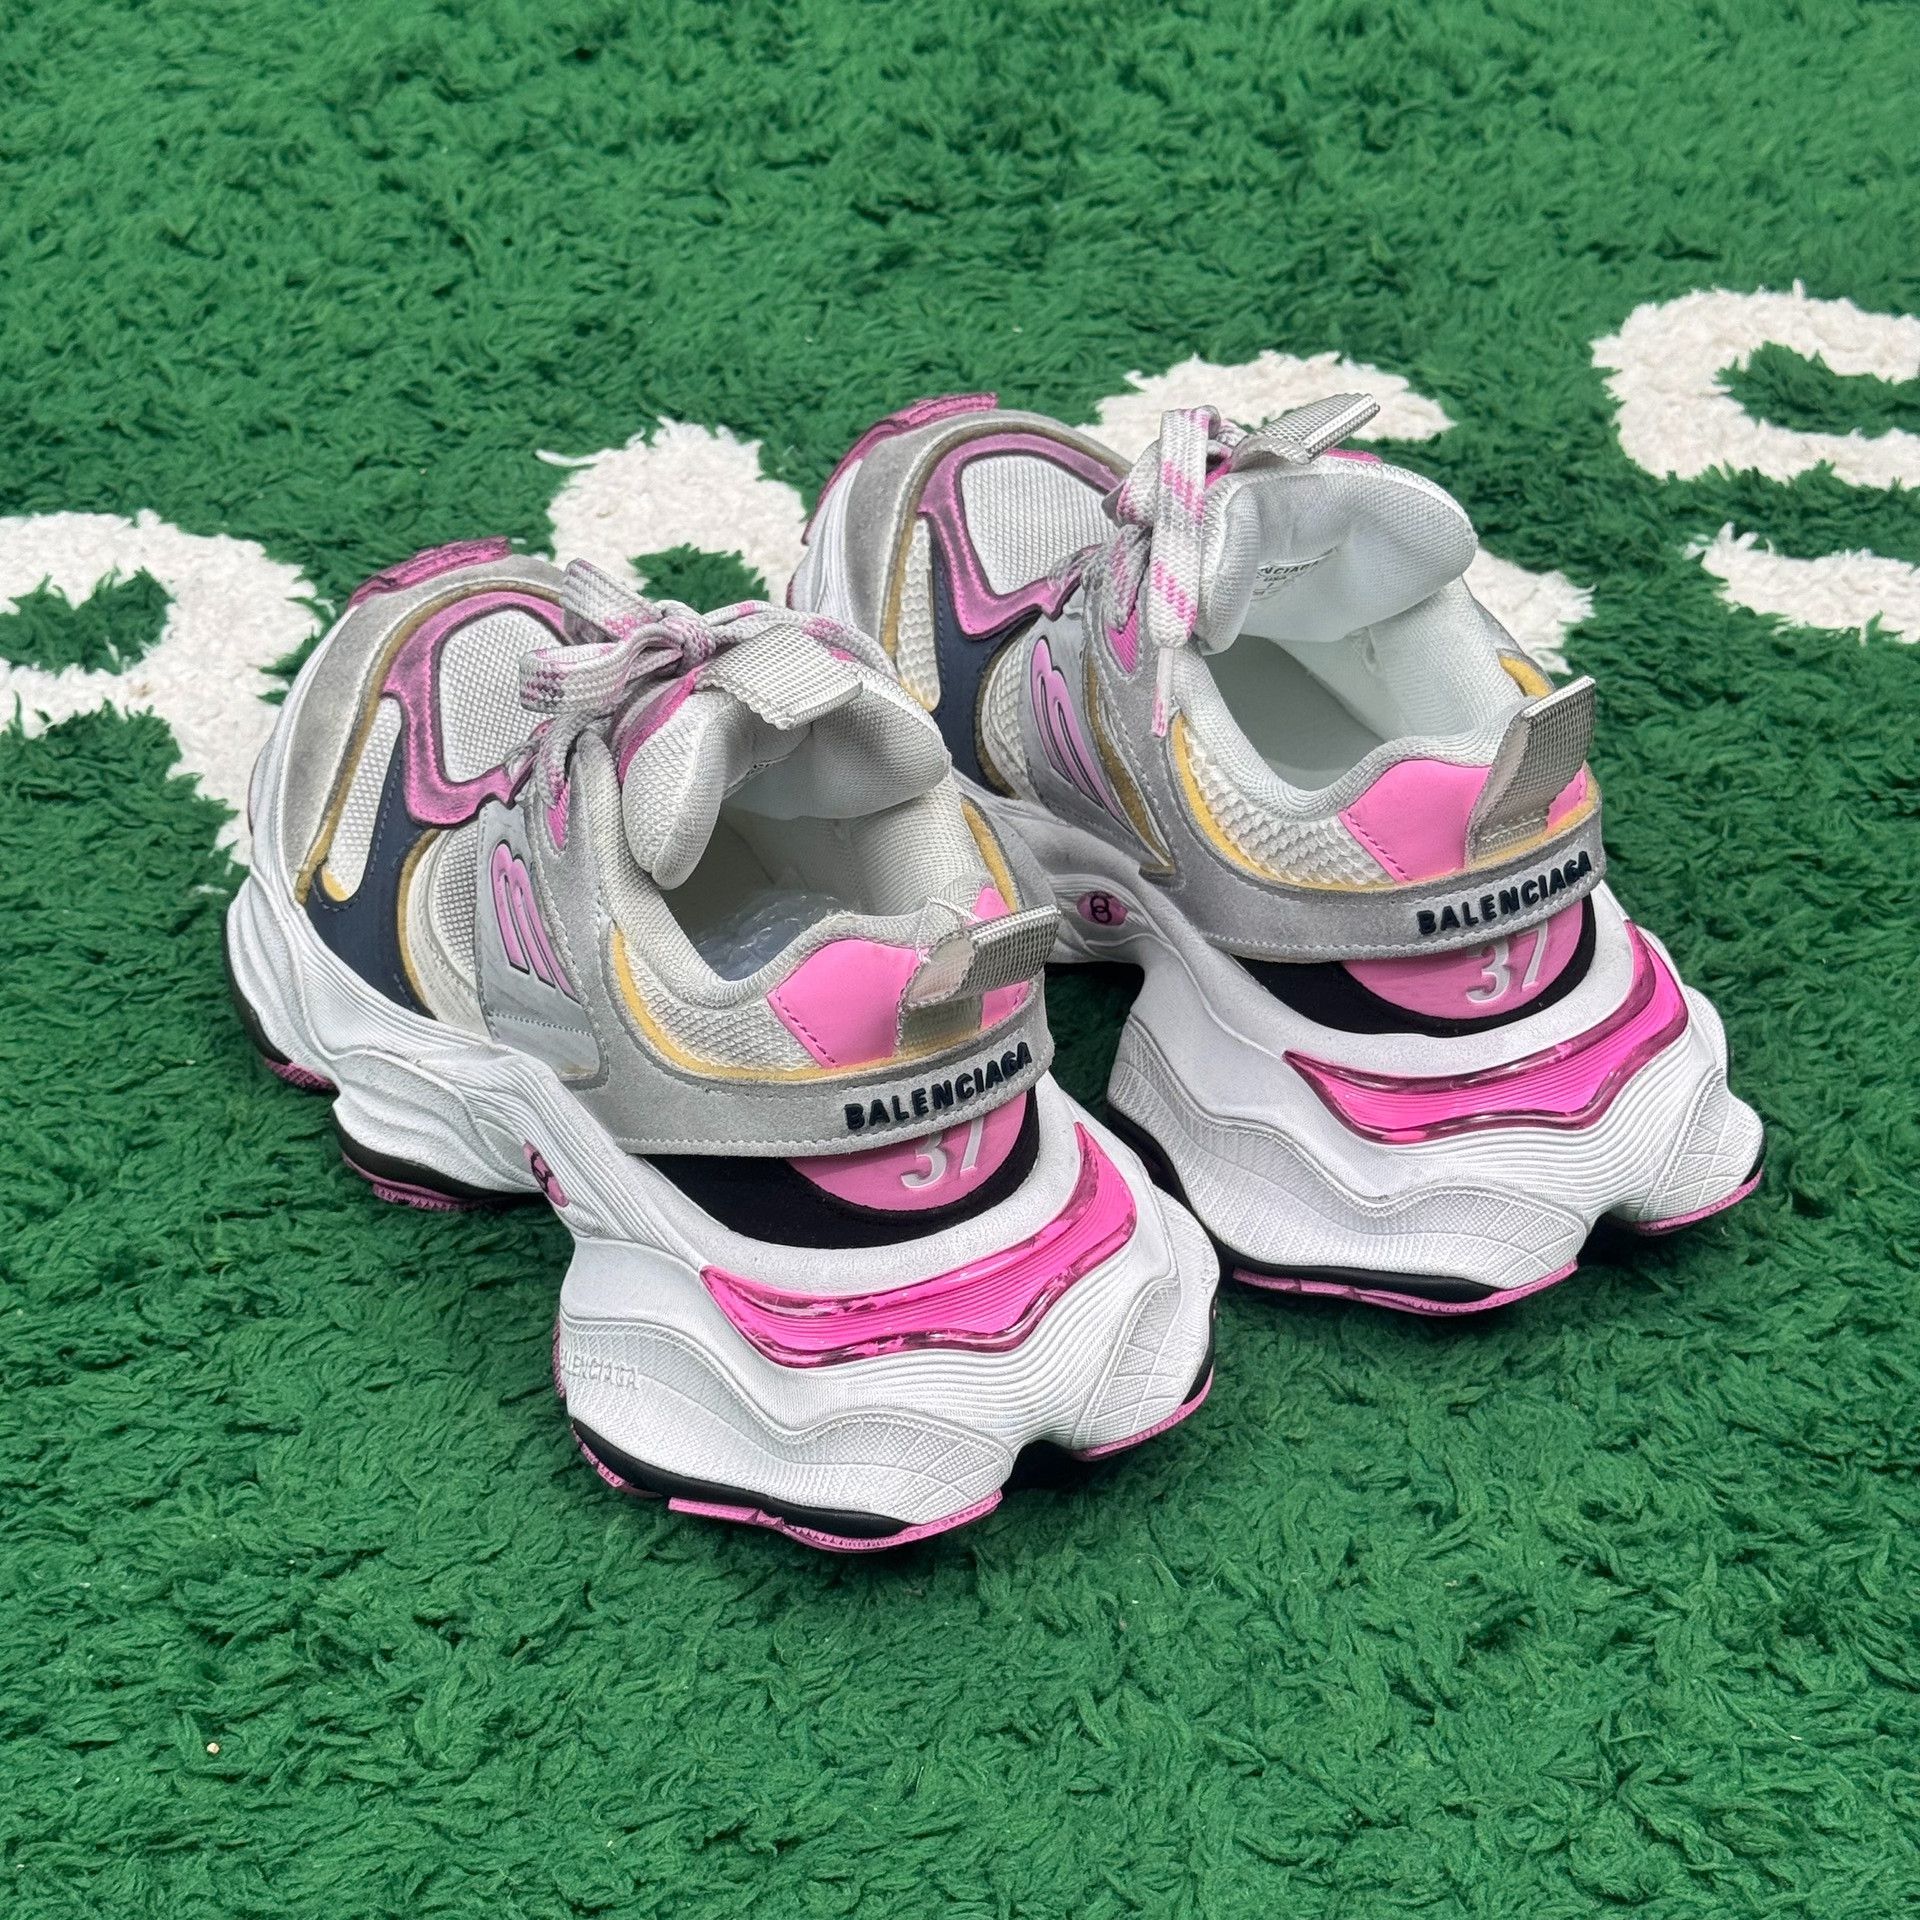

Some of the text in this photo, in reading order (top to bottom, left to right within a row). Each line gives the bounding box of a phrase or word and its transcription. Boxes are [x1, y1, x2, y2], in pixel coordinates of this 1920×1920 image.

[1416, 850, 1592, 935] BALENCIAGA
[1465, 920, 1549, 1004] 37
[844, 1041, 1032, 1131] BALENCIAGA
